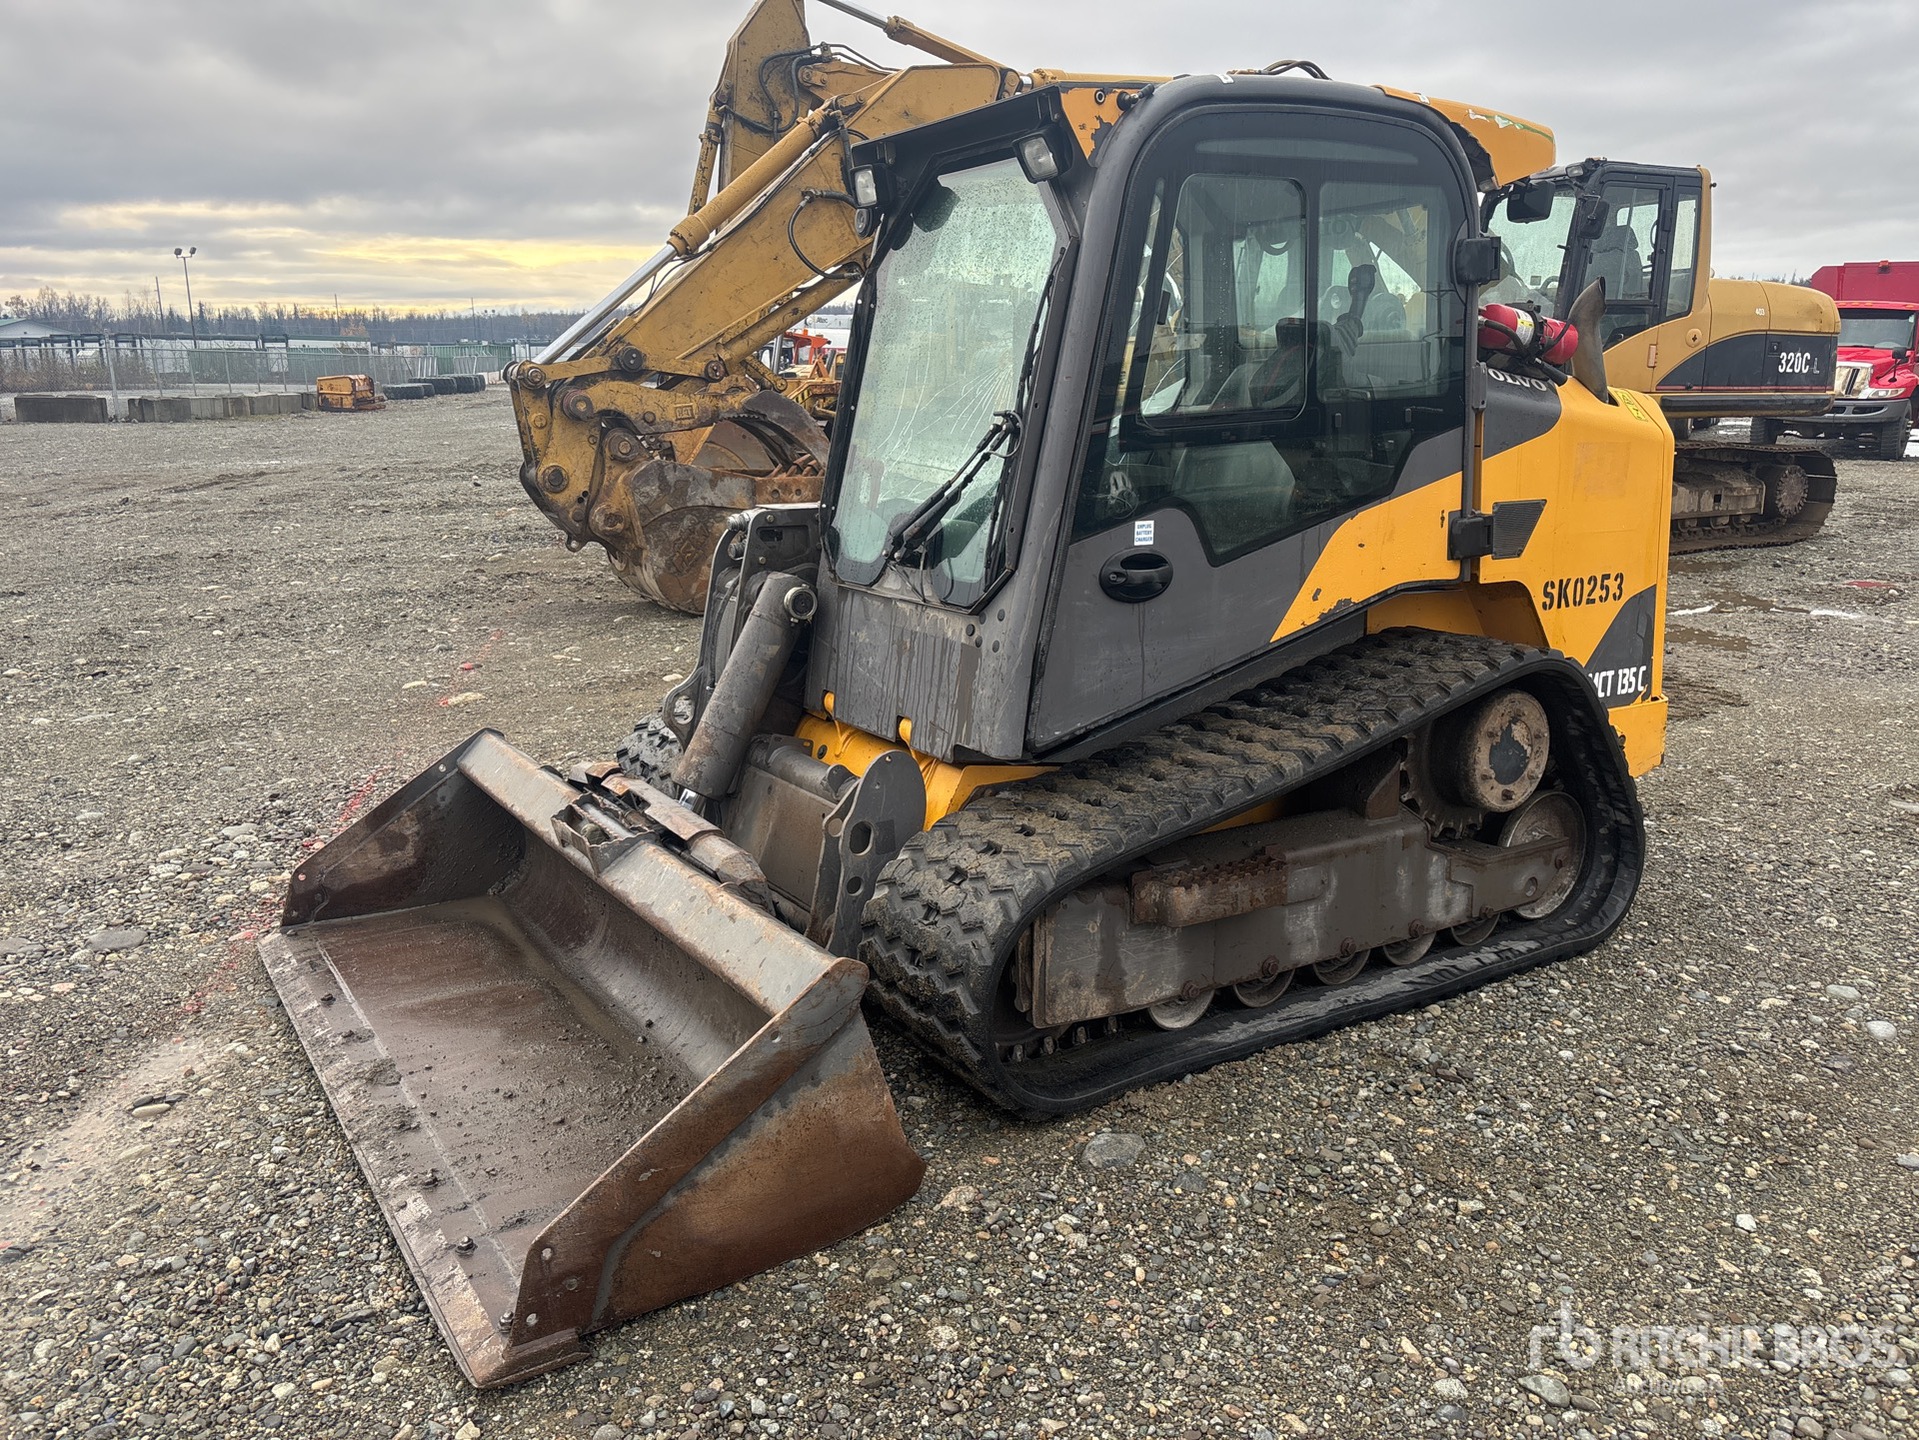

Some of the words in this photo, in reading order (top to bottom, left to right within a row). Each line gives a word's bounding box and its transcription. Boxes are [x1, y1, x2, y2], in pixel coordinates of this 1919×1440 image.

[1778, 352, 1811, 374] 320C
[1488, 368, 1547, 392] OLVO
[1541, 572, 1625, 611] SK0253
[1617, 665, 1637, 696] 135
[1637, 665, 1647, 692] C
